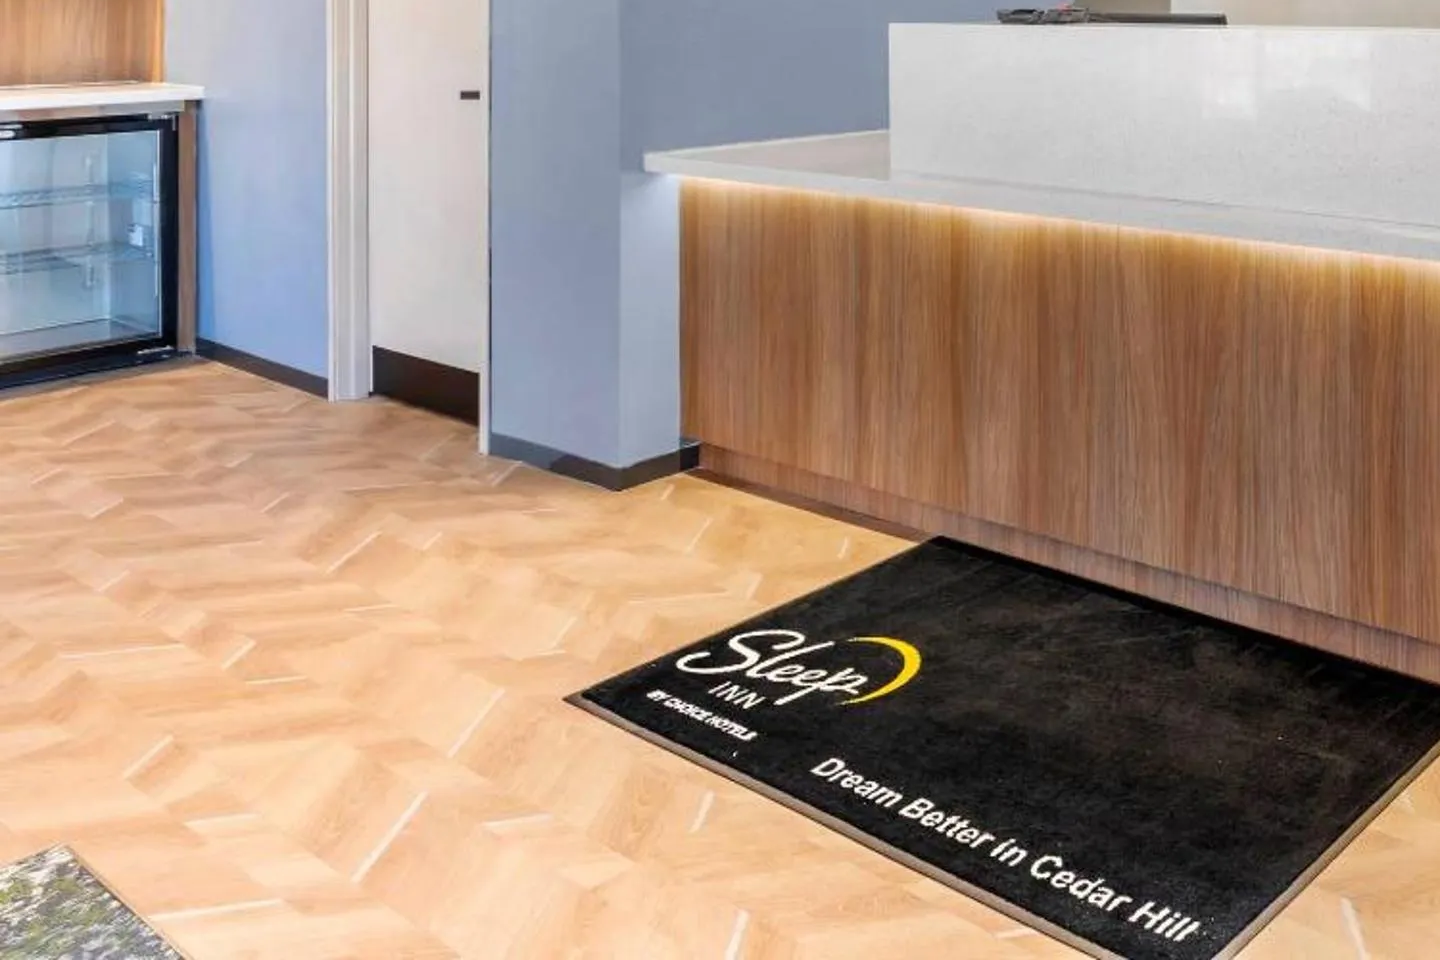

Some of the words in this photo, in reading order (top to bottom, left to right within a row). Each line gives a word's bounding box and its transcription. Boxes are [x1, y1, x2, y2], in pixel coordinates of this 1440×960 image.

[676, 629, 869, 706] Sleep
[708, 681, 766, 710] INN
[663, 697, 713, 721] CHOICE
[705, 715, 758, 740] HOTELS
[810, 757, 903, 808] Dream
[899, 797, 996, 849] Better
[1030, 854, 1133, 912] Cedar
[1128, 901, 1200, 942] Hill
